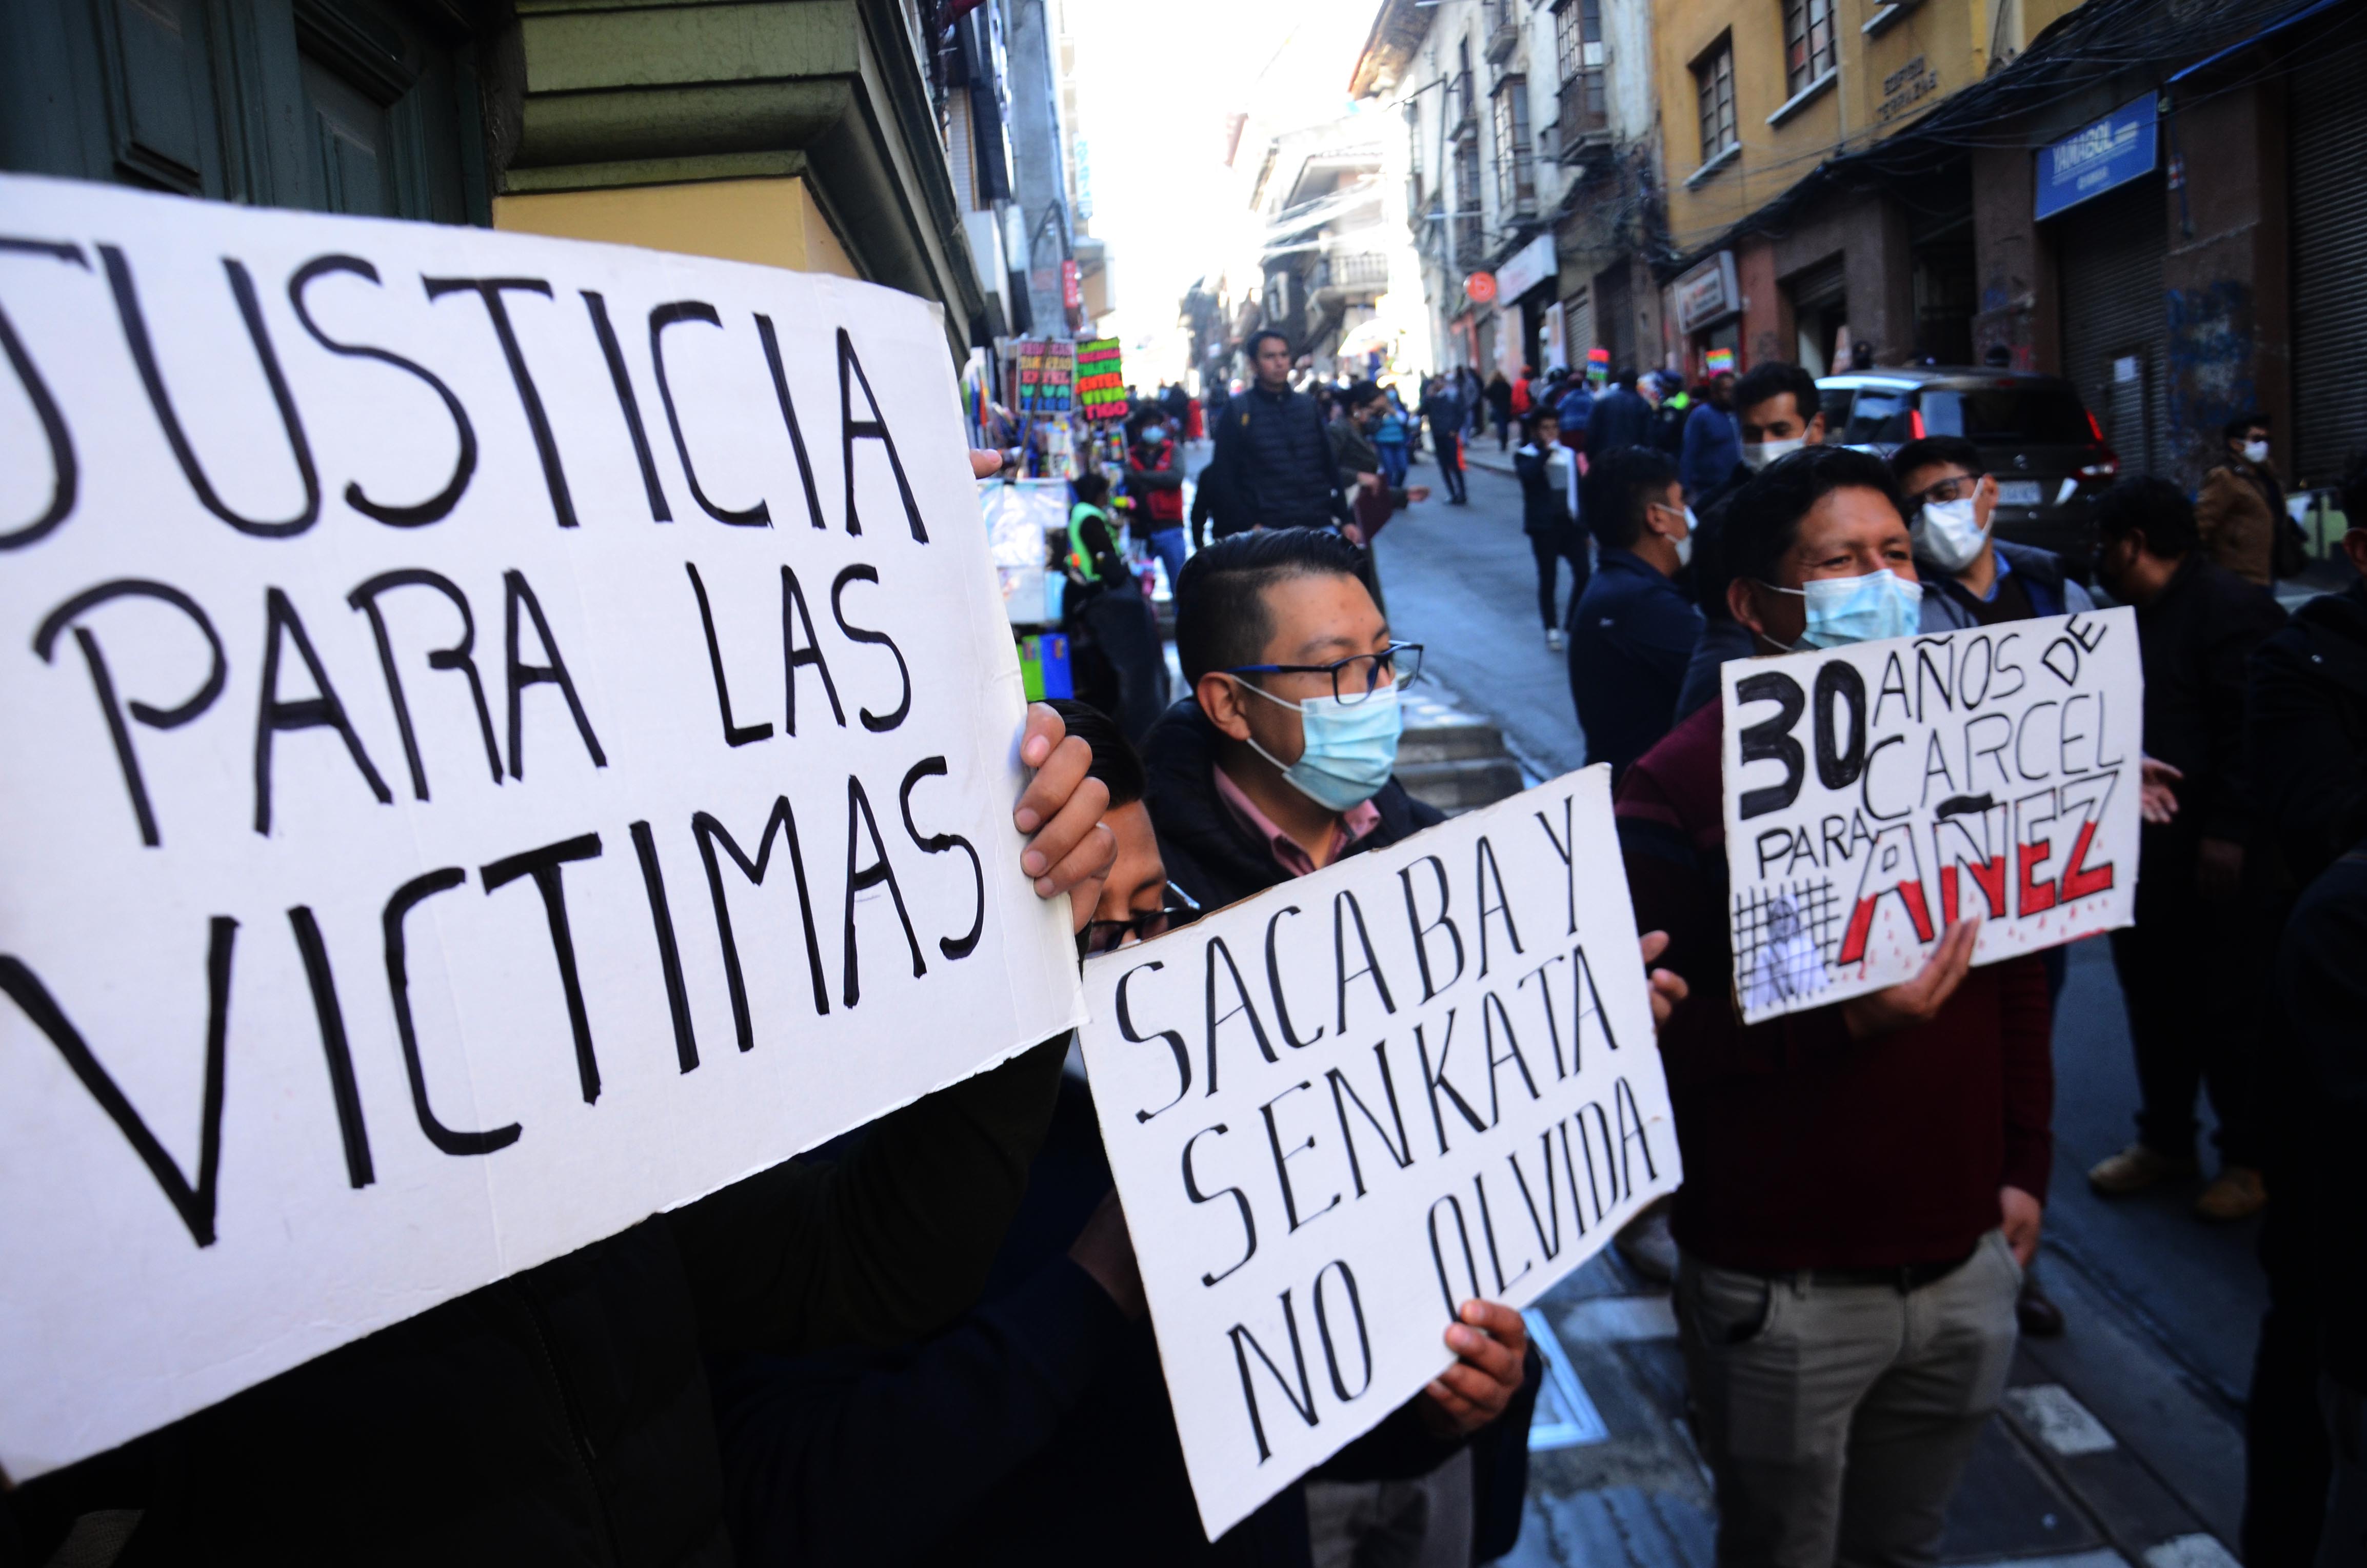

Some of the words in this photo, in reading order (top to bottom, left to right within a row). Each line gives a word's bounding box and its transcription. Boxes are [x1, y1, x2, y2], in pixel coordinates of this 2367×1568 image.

[0, 240, 930, 550] JUSTICIA
[1021, 385, 1070, 398] VVA
[1081, 387, 1125, 406] VIVA
[1085, 401, 1128, 421] TIGO
[33, 568, 608, 847] PARA
[686, 563, 912, 746] LAS
[1737, 659, 1866, 820] 30
[1873, 634, 2026, 727] AÑOS
[2041, 614, 2106, 686] DE
[1862, 690, 2124, 821] CARCEL
[1756, 808, 1879, 878] PARA
[1838, 770, 2119, 966] AÑEZ
[0, 756, 986, 1249] VICTIMAS
[1115, 835, 1524, 1124] SACABA
[1536, 795, 1578, 937] Y
[1181, 944, 1619, 1288] SENKATA
[1226, 1259, 1373, 1466] NO
[1427, 1076, 1658, 1324] OLVIDA
